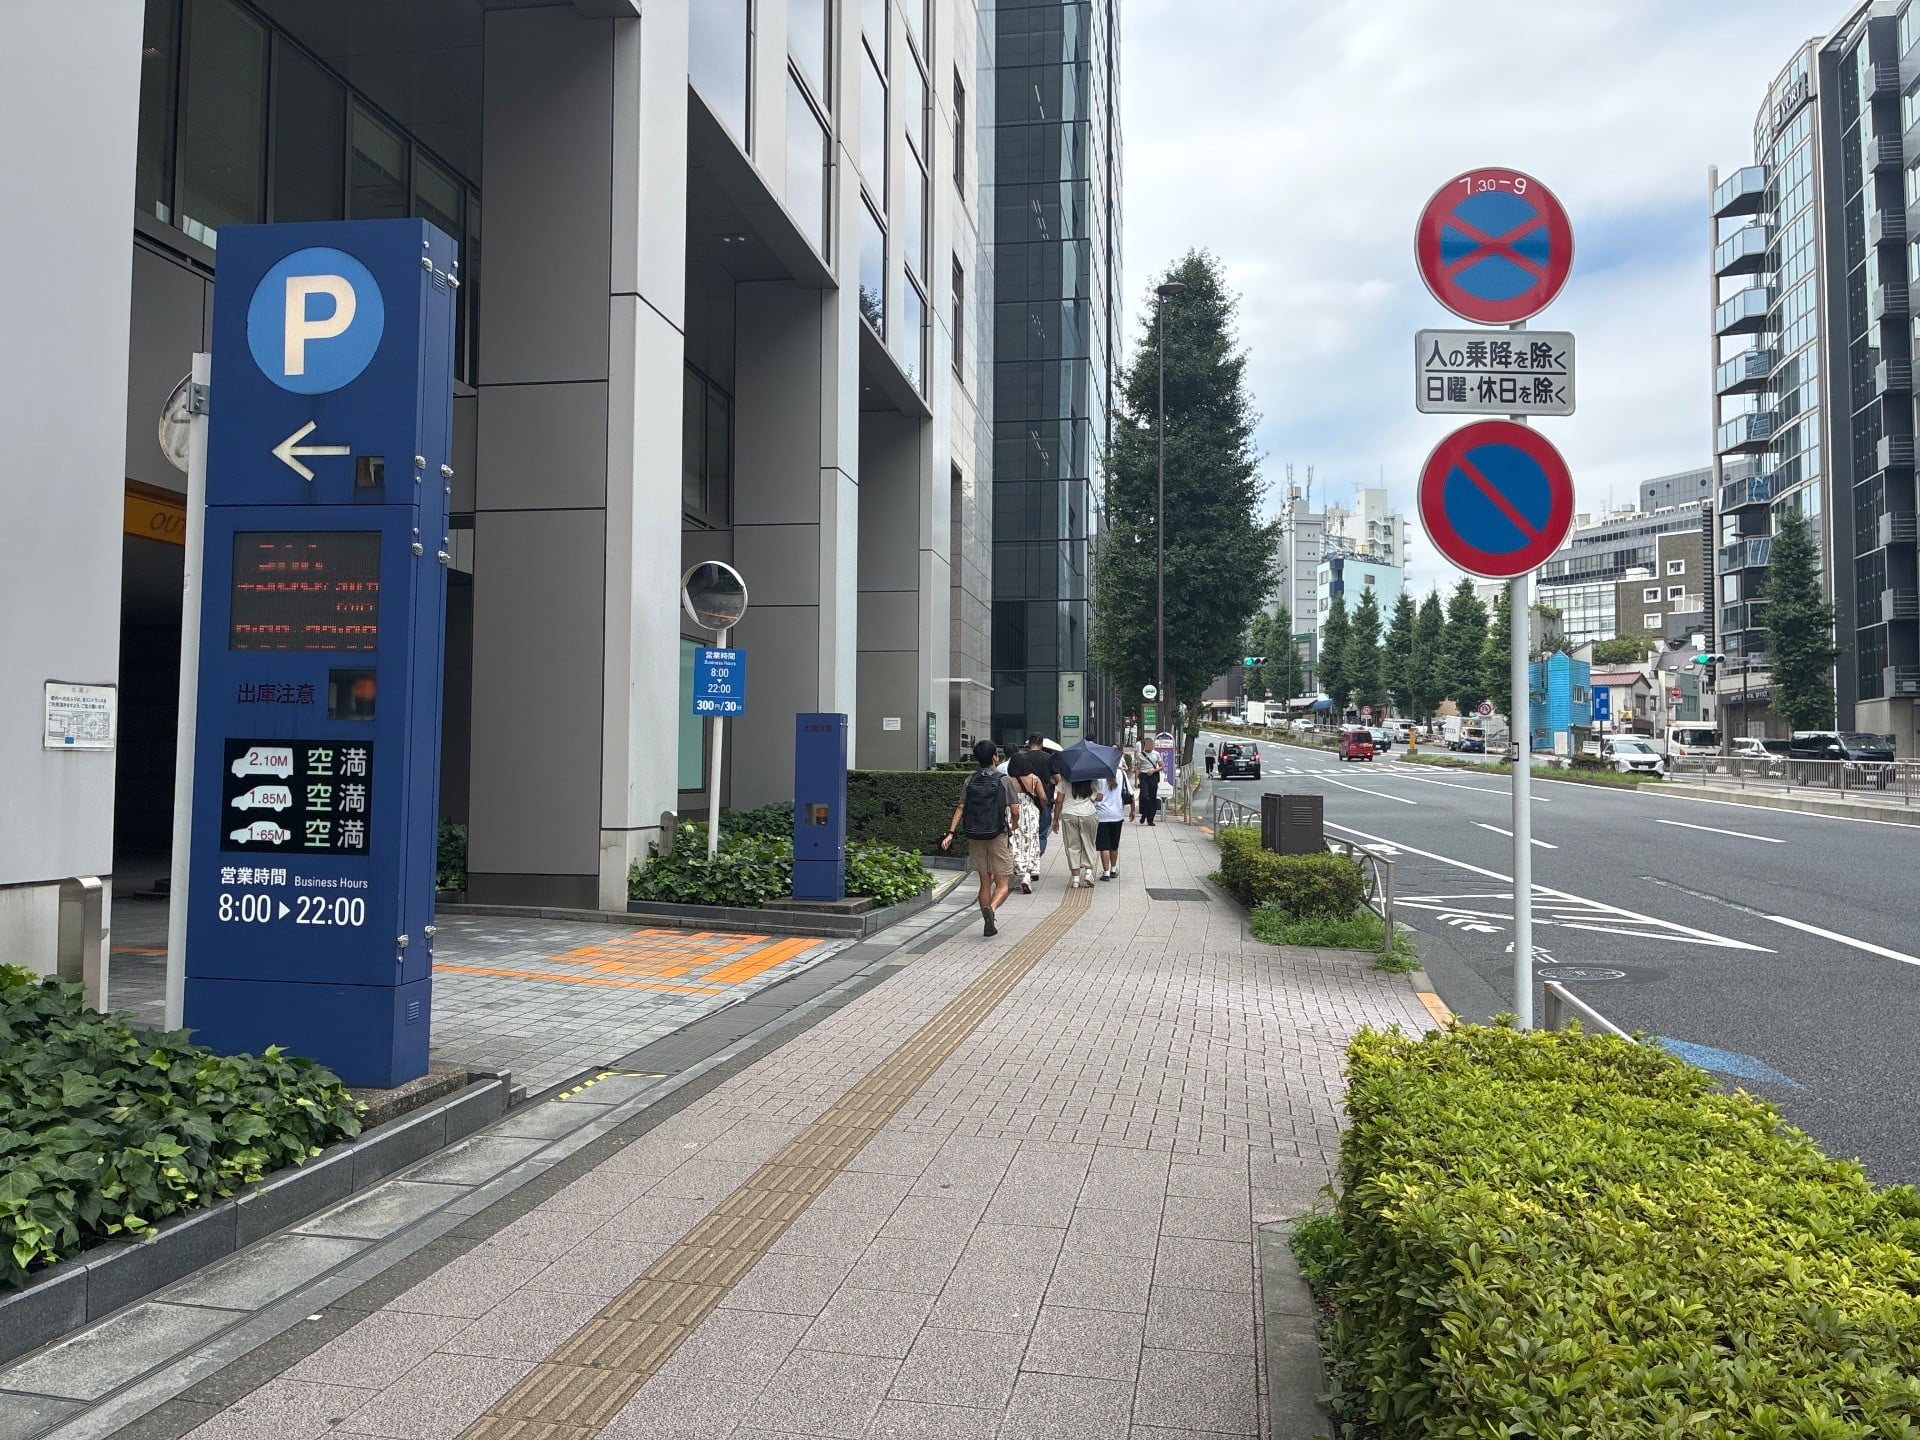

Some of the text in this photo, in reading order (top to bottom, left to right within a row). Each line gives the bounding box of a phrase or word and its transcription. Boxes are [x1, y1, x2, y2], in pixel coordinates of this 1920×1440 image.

[283, 274, 357, 376] P
[1426, 340, 1566, 370] 人の乗降を除く
[1427, 376, 1566, 405] 日曜・休日を除く
[705, 651, 736, 660] 営業時間
[710, 668, 729, 677] 8:00
[237, 682, 316, 705] 出庫注意
[707, 684, 731, 693] 22:00
[249, 747, 367, 778] 2.10M 空 満
[248, 783, 366, 814] 1.85M 空 満
[304, 819, 331, 848] 空
[337, 819, 365, 849] 満
[220, 866, 368, 889] 営業時間 Business Hours
[218, 893, 366, 927] 8:00 22:00
